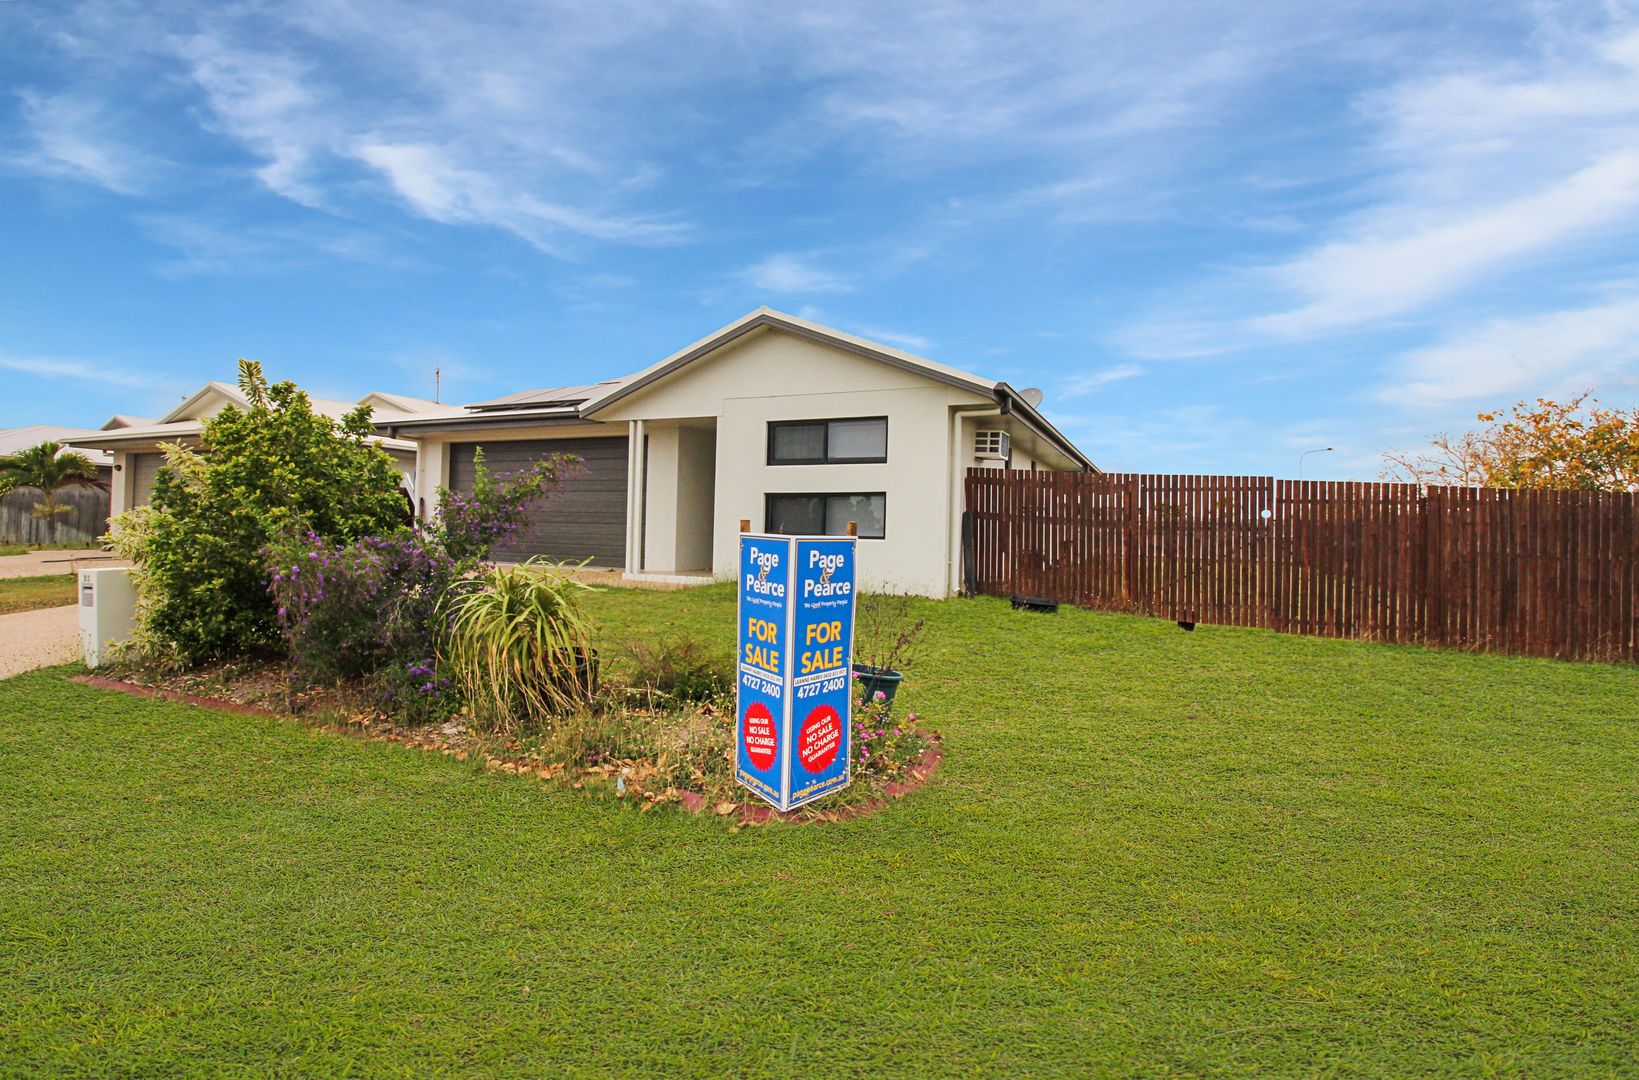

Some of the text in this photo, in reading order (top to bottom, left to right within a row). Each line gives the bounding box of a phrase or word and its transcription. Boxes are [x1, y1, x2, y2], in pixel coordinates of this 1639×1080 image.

[750, 546, 779, 572] Page
[809, 550, 844, 573] Page
[746, 573, 785, 597] Pearce
[820, 568, 833, 584] &
[804, 579, 851, 598] Pearce
[748, 617, 777, 645] FOR
[806, 621, 842, 646] FOR
[745, 643, 779, 673] SALE
[801, 646, 843, 674] SALE
[742, 674, 760, 690] 4727
[761, 681, 781, 699] 2400
[797, 677, 845, 698] 4727 2400
[749, 726, 770, 735] NO SALE
[805, 715, 831, 734] USING OUR
[806, 722, 833, 744] NO SALE
[746, 736, 775, 746] NO CHARGE
[802, 729, 839, 757] NO CHARGE
[808, 741, 835, 762] GUARANTEE
